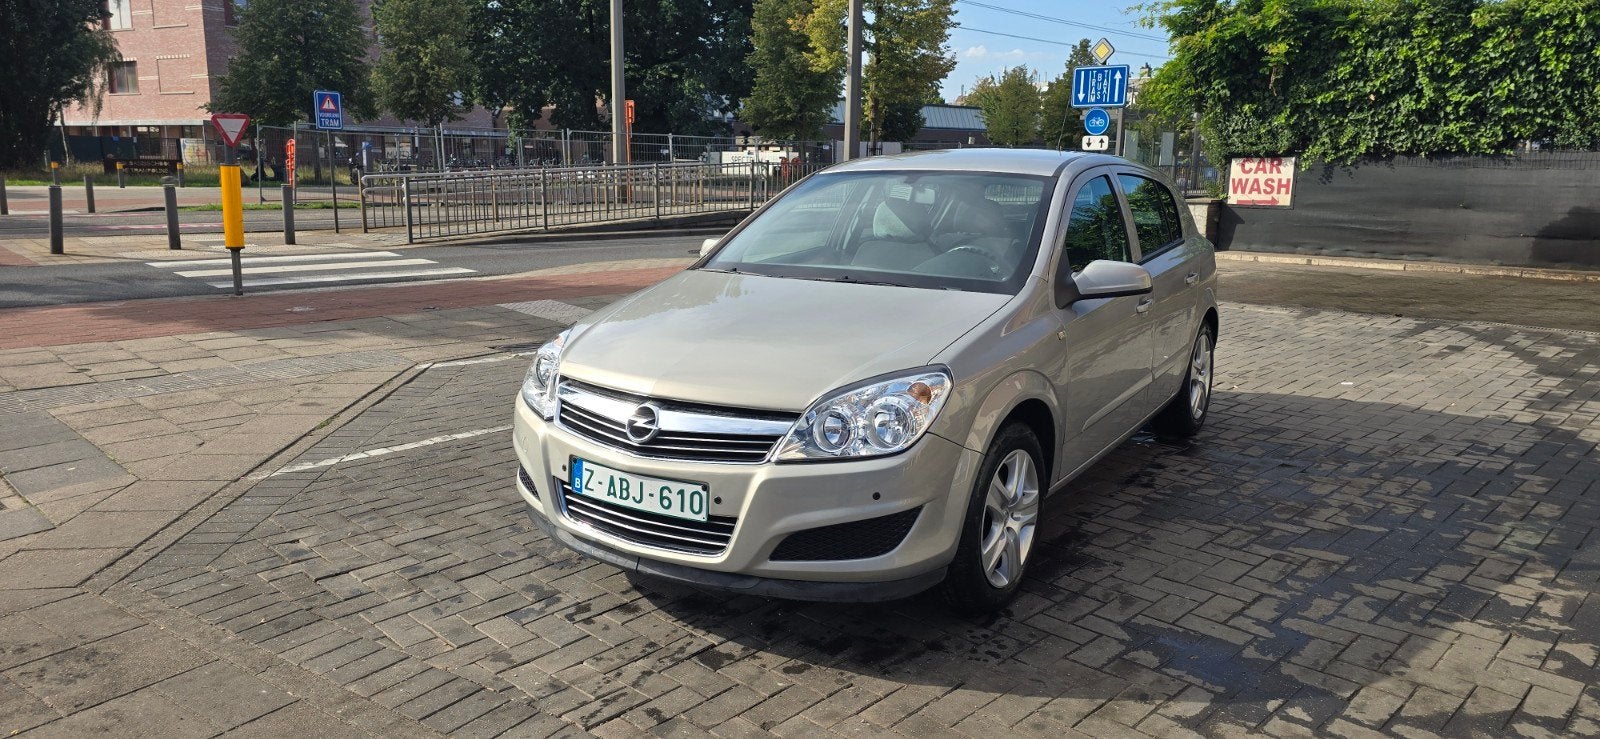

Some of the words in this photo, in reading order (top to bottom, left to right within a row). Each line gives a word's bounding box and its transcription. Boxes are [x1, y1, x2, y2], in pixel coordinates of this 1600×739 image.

[320, 118, 339, 126] TRAM
[1240, 157, 1282, 174] CAR
[1231, 178, 1291, 195] WASH
[574, 477, 581, 488] B
[584, 468, 704, 515] Z-ABJ-610
